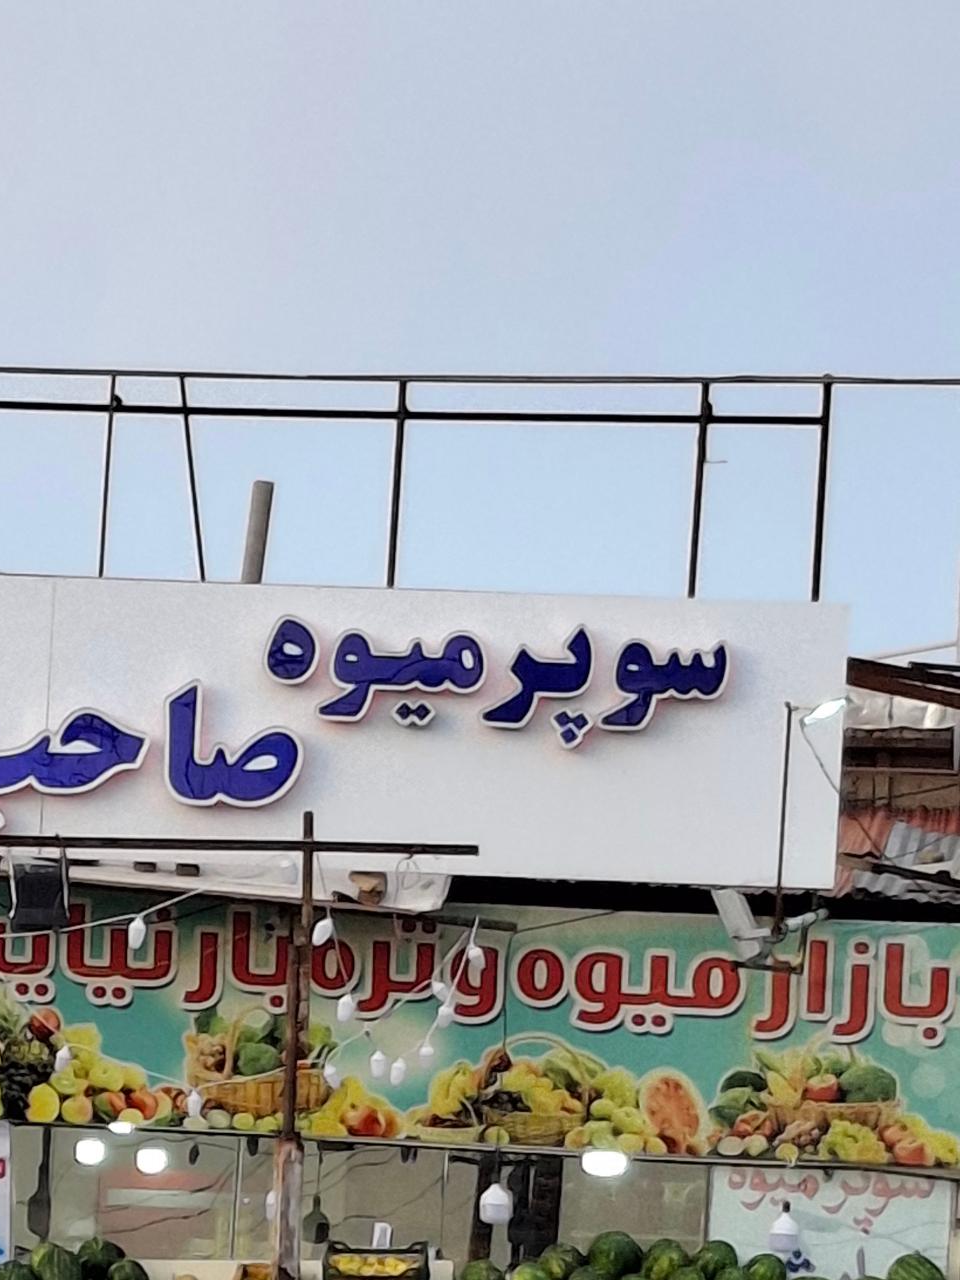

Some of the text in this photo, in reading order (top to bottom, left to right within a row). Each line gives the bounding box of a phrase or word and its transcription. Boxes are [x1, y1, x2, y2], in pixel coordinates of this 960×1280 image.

[265, 613, 732, 750] سوپر میوه
[450, 943, 504, 1020] و
[515, 945, 743, 1031] میوه
[750, 936, 954, 1044] بازار
[820, 1169, 936, 1237] سوپر
